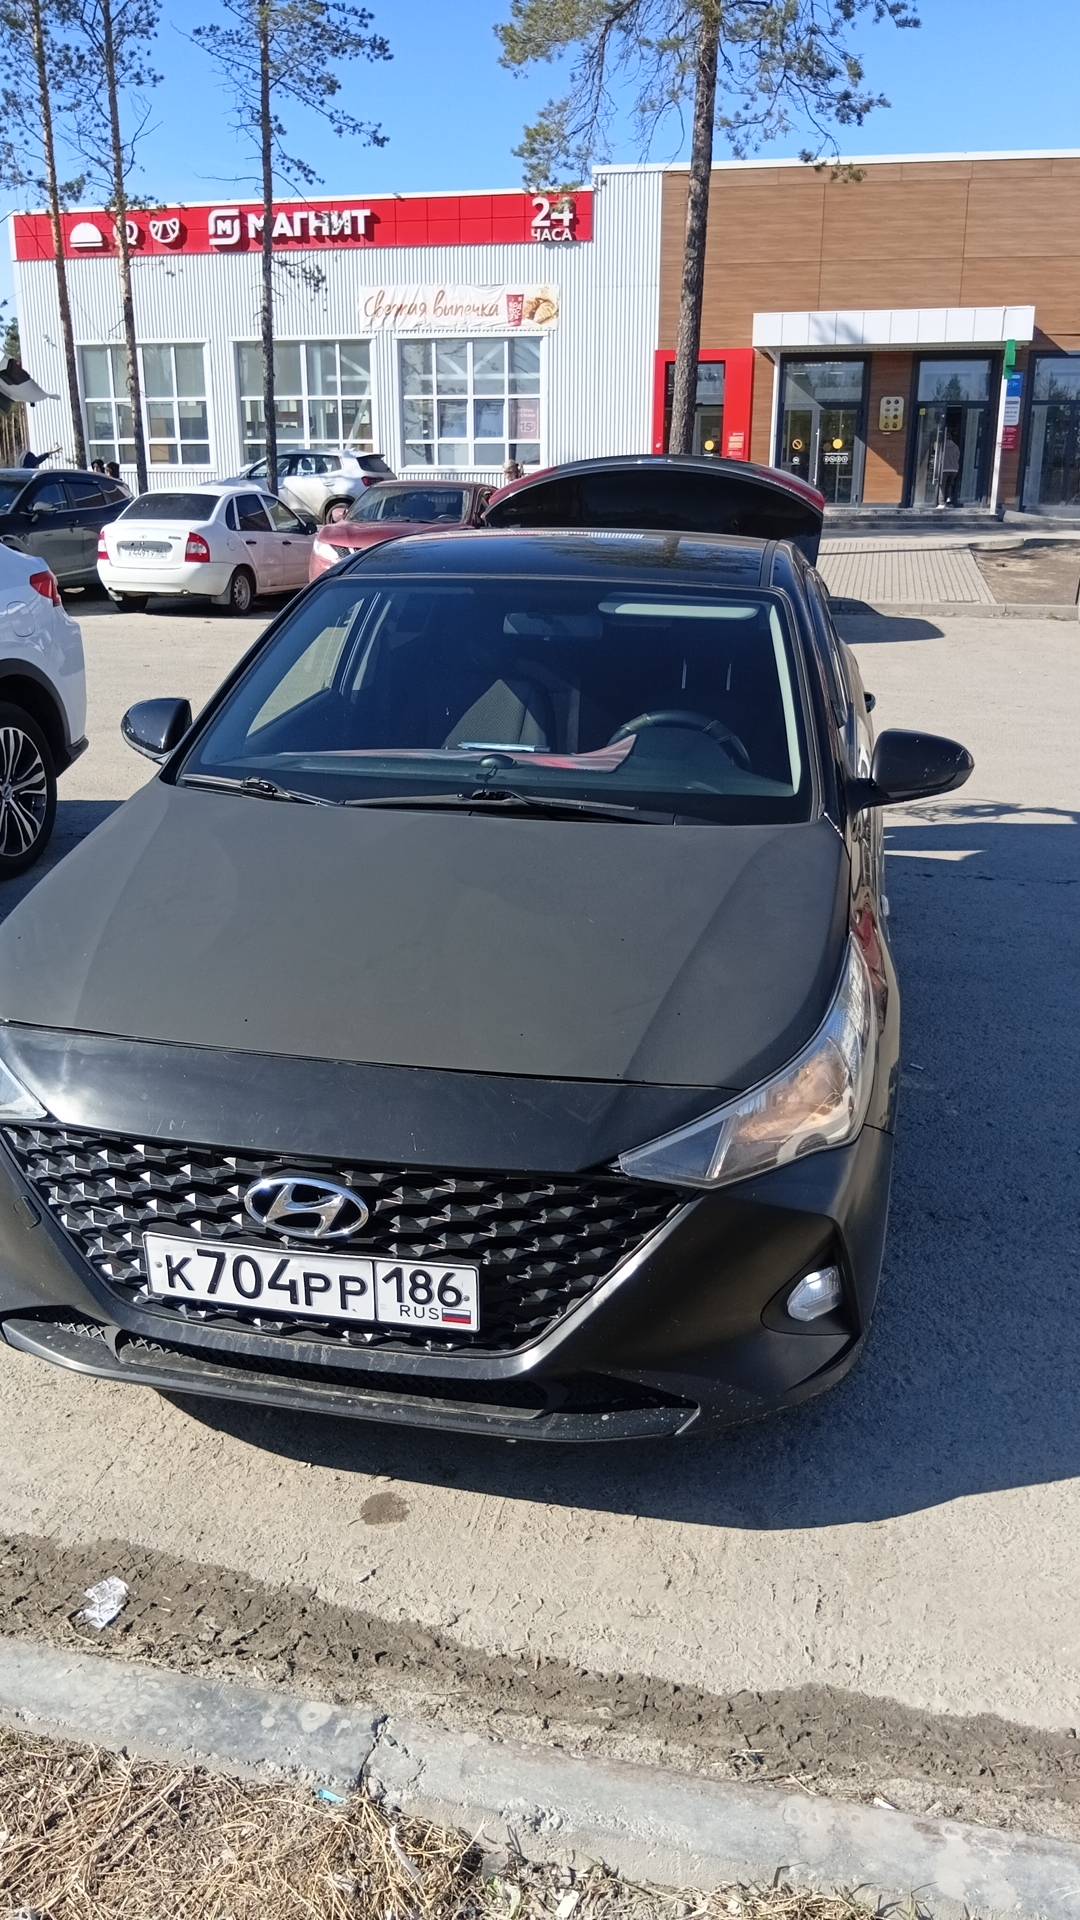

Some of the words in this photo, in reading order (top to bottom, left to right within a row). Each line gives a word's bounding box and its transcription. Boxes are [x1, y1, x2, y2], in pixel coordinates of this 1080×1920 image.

[248, 209, 371, 239] МАГНИТ
[531, 196, 573, 227] 24
[531, 227, 573, 241] ЧАСА
[433, 289, 500, 318] выпечка
[165, 1248, 368, 1310] К704РР
[382, 1266, 463, 1308] 186
[400, 1304, 439, 1320] RUS
